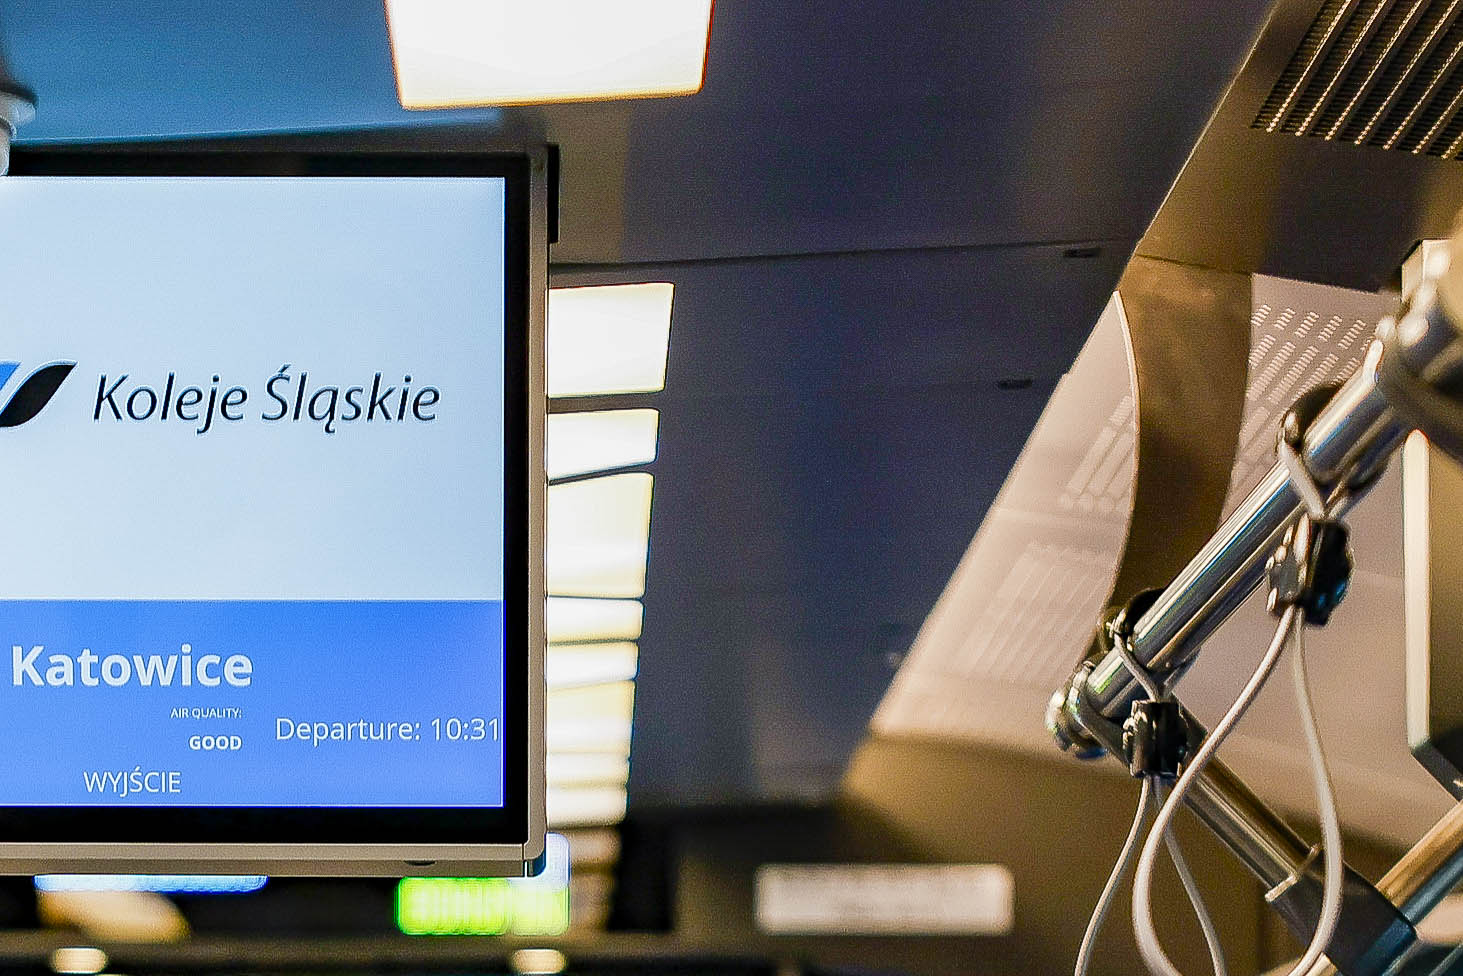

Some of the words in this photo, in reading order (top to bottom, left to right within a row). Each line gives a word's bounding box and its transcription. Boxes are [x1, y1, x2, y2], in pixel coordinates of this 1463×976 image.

[92, 372, 248, 435] Koleje
[261, 362, 441, 435] Śląskie
[10, 642, 254, 689] Katowice
[170, 707, 189, 719] AIR
[192, 707, 243, 720] QUALITY:
[188, 735, 243, 751] GOOD
[275, 717, 422, 747] Departure:
[431, 717, 499, 741] 10:31
[83, 766, 181, 797] WYJŚCIE
